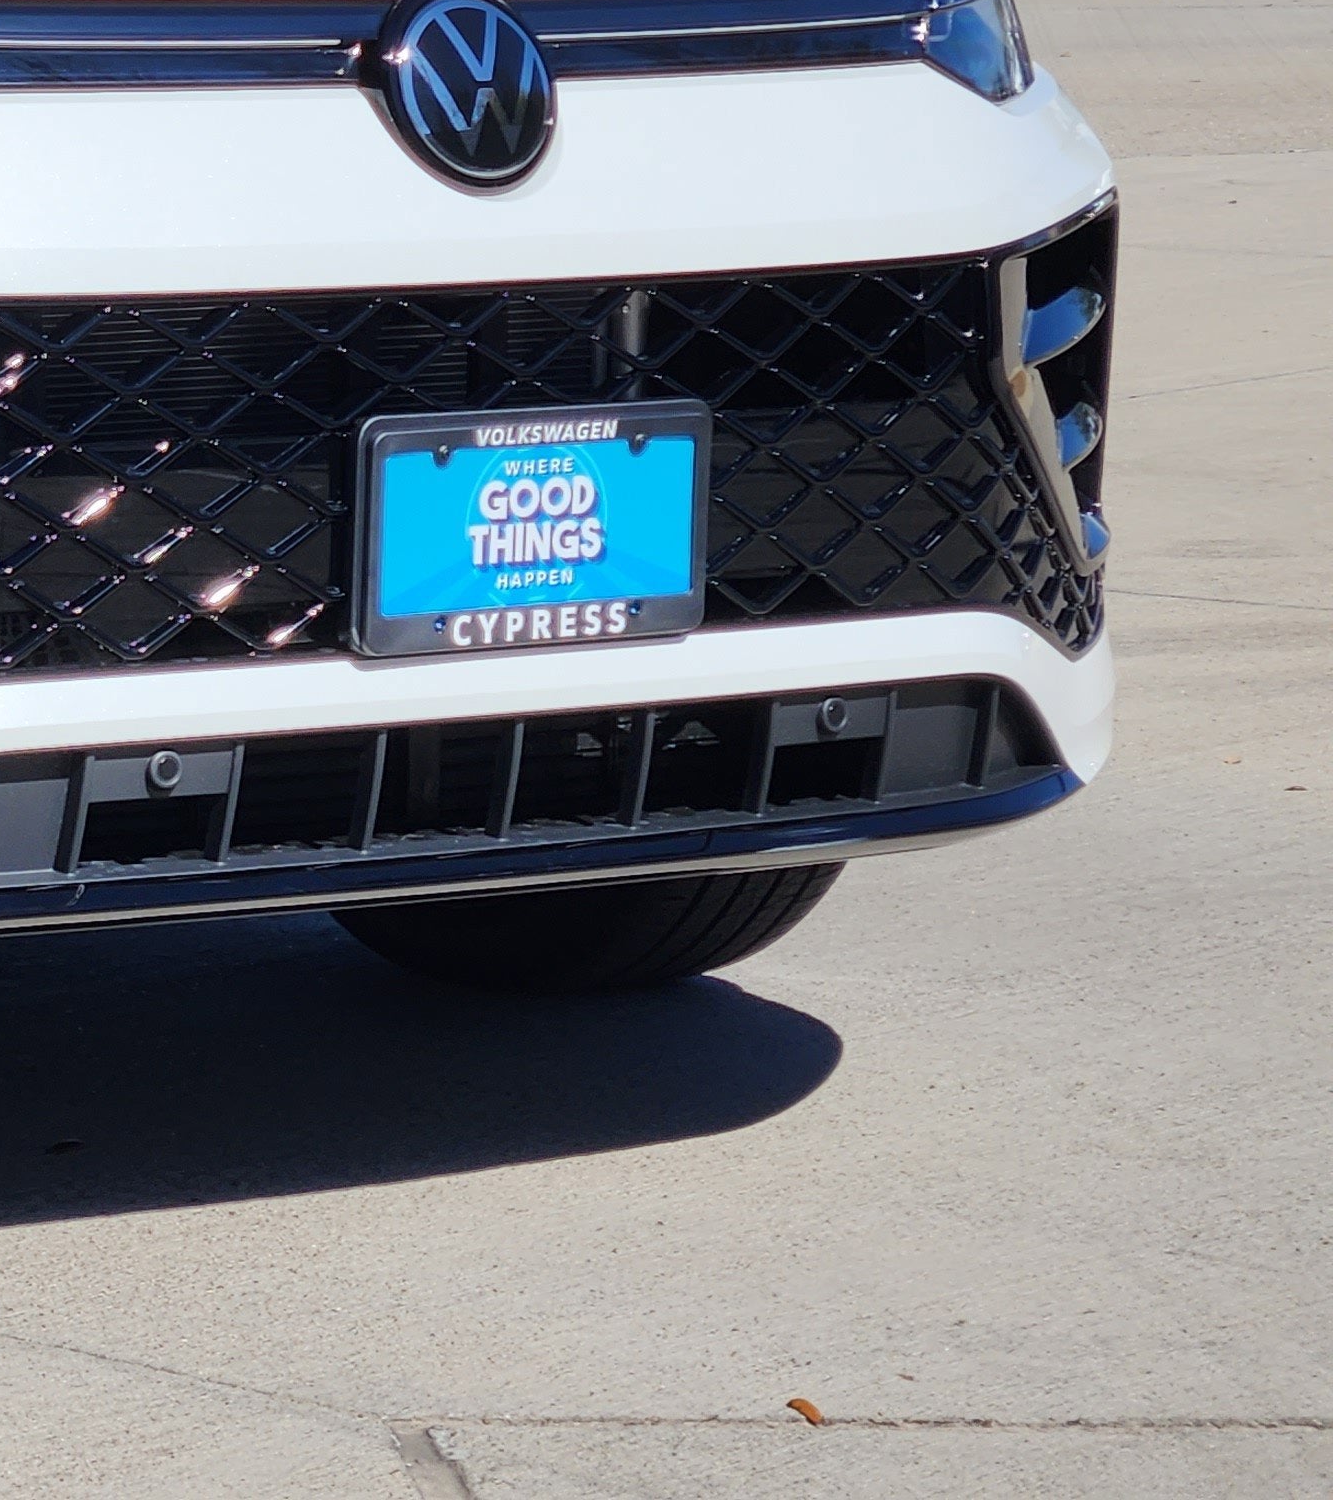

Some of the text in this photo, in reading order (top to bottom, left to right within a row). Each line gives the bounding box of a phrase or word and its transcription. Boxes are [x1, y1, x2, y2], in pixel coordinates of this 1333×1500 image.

[475, 419, 619, 448] VOLKSWAGEN
[503, 457, 575, 477] WHERE
[478, 475, 596, 521] GOOD
[468, 517, 603, 566] THINGS
[495, 569, 574, 591] HAPPEN
[451, 602, 628, 647] CYPRESS
